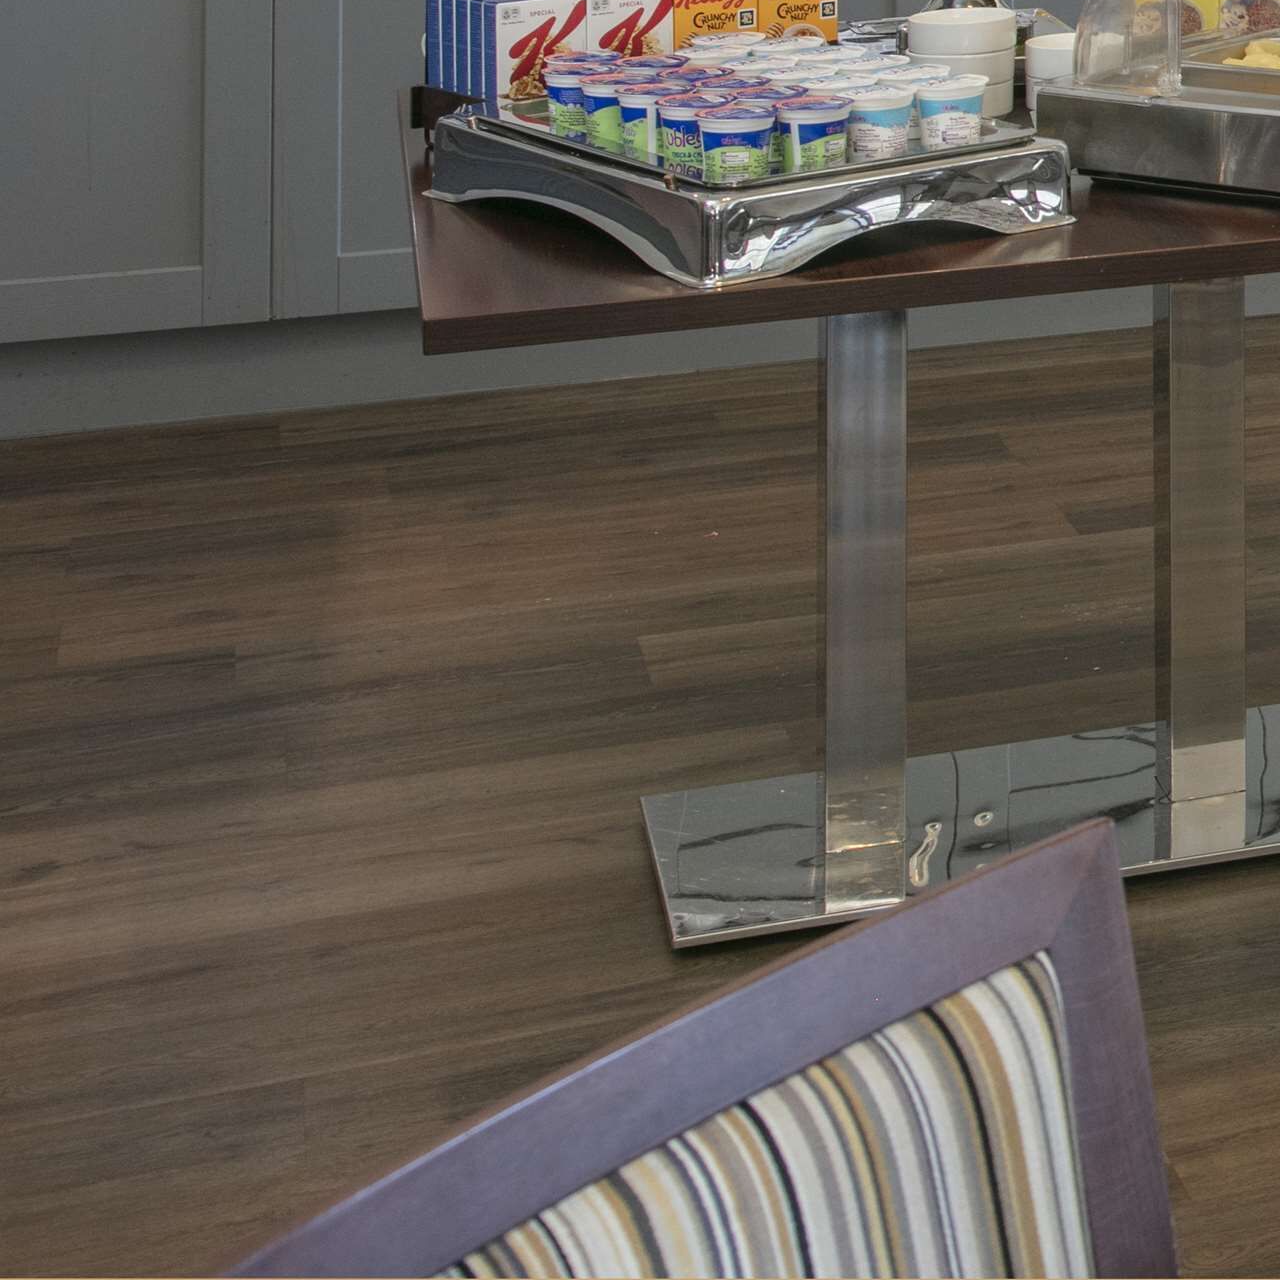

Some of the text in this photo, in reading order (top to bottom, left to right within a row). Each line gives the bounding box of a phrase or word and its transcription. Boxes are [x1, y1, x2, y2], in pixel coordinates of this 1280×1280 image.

[619, 0, 644, 8] SPECIAL
[529, 8, 555, 17] SPECIAL
[776, 2, 820, 19] CRUNCHY
[693, 11, 737, 28] CRUNCHY
[790, 13, 809, 22] NUT
[707, 22, 727, 31] NUT
